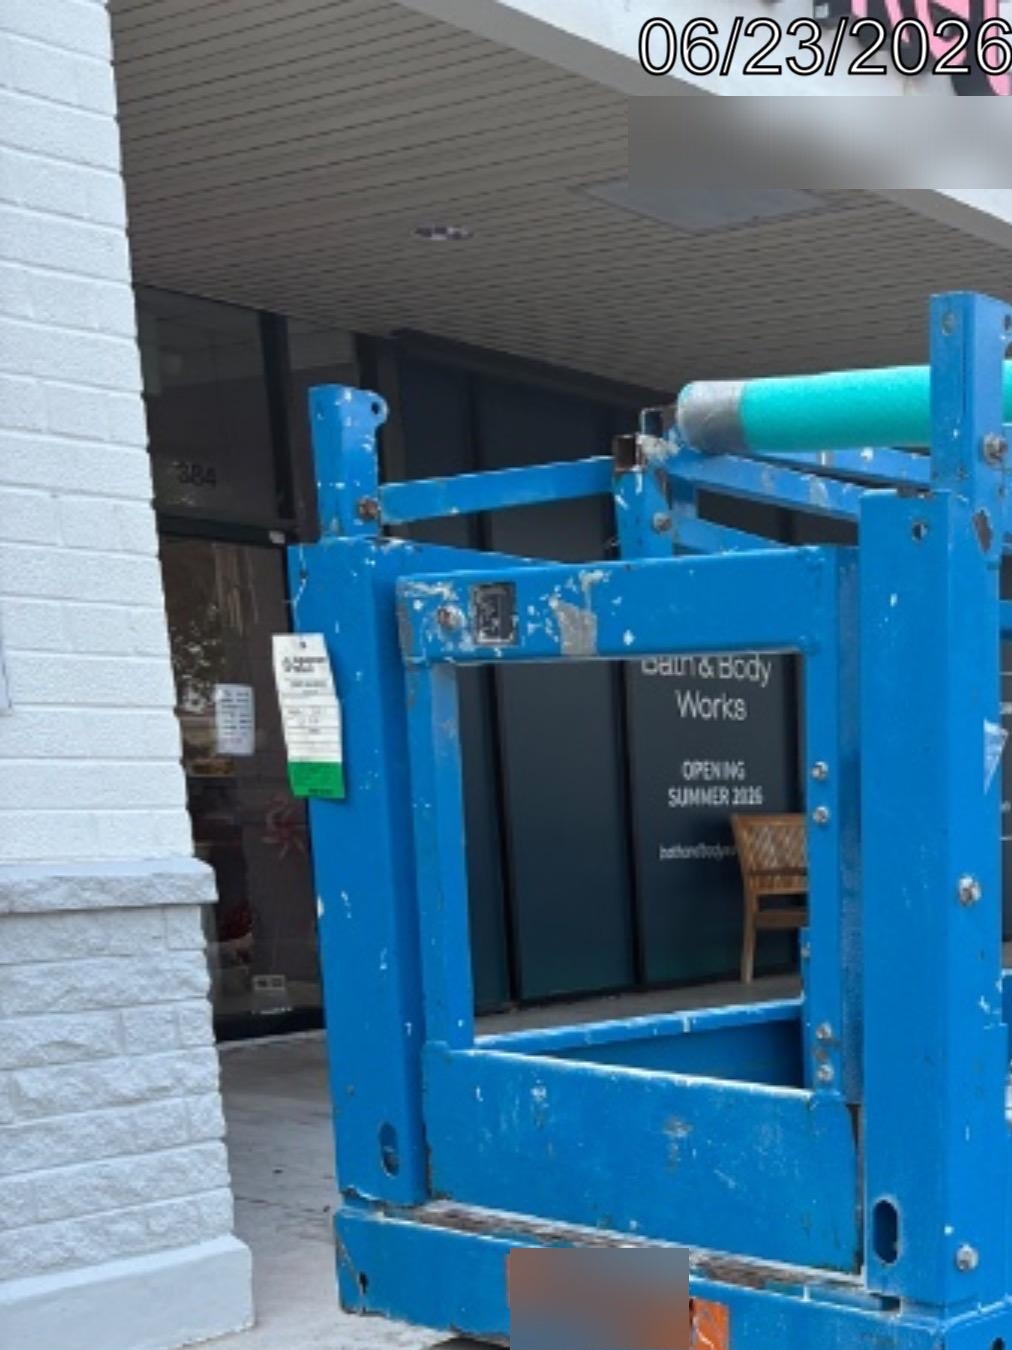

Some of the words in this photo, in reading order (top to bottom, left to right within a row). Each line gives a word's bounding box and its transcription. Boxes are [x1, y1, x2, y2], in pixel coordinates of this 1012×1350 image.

[698, 657, 714, 679] &
[719, 654, 771, 688] Body
[675, 689, 747, 721] Works
[682, 760, 745, 781] OPENING
[668, 786, 729, 807] SUMMER
